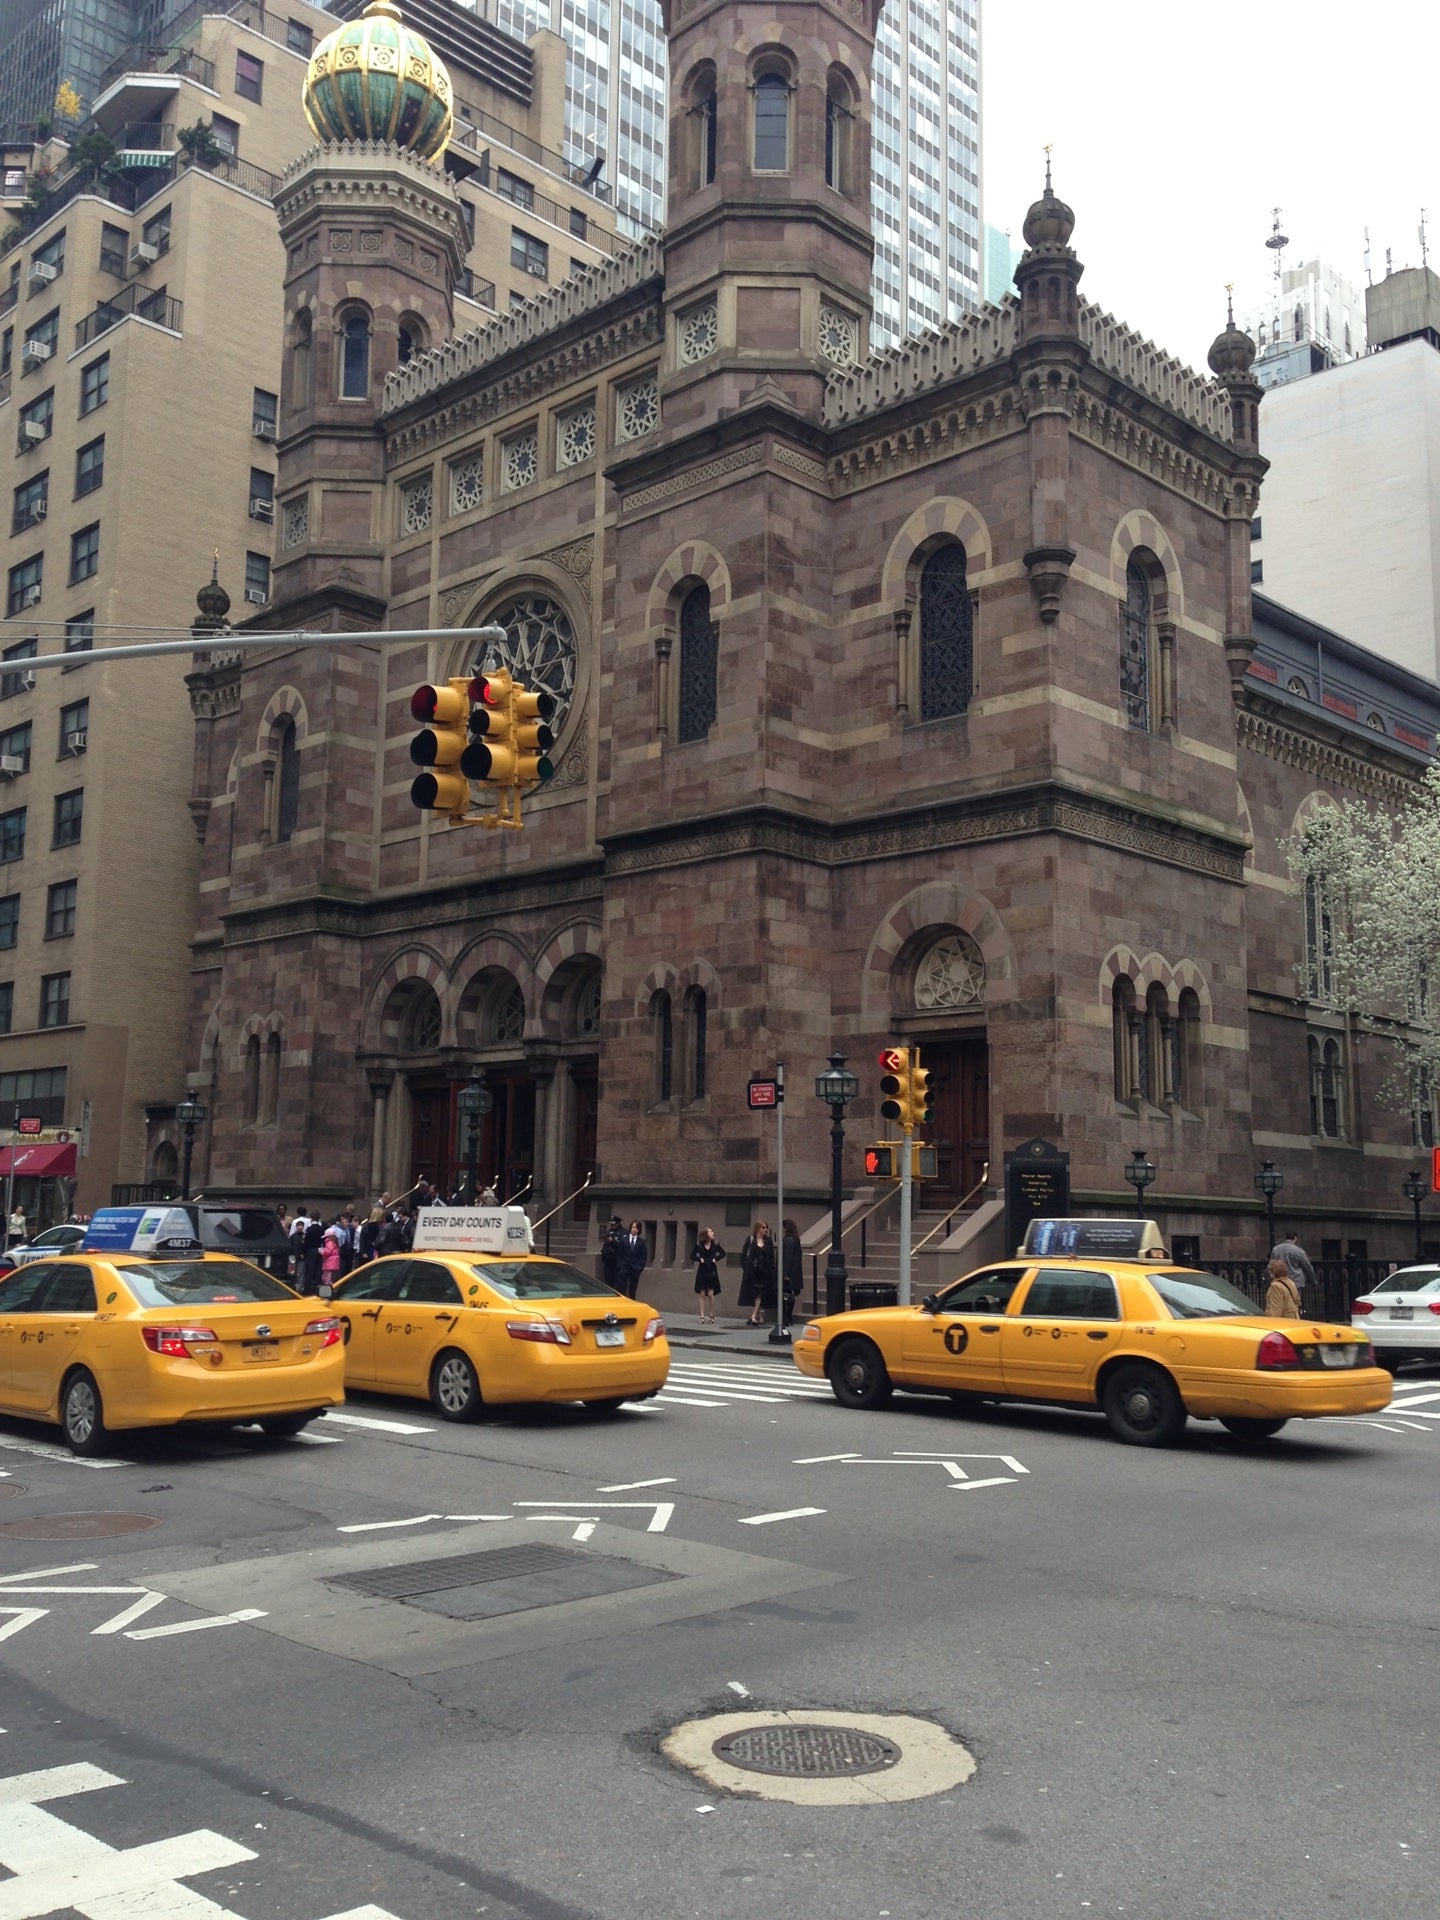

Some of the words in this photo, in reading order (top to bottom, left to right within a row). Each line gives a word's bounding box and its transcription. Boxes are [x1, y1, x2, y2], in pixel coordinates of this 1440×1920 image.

[422, 1217, 448, 1227] EVERY
[449, 1217, 465, 1228] DAY
[466, 1217, 502, 1229] COUNTS
[167, 1239, 192, 1248] 4M37
